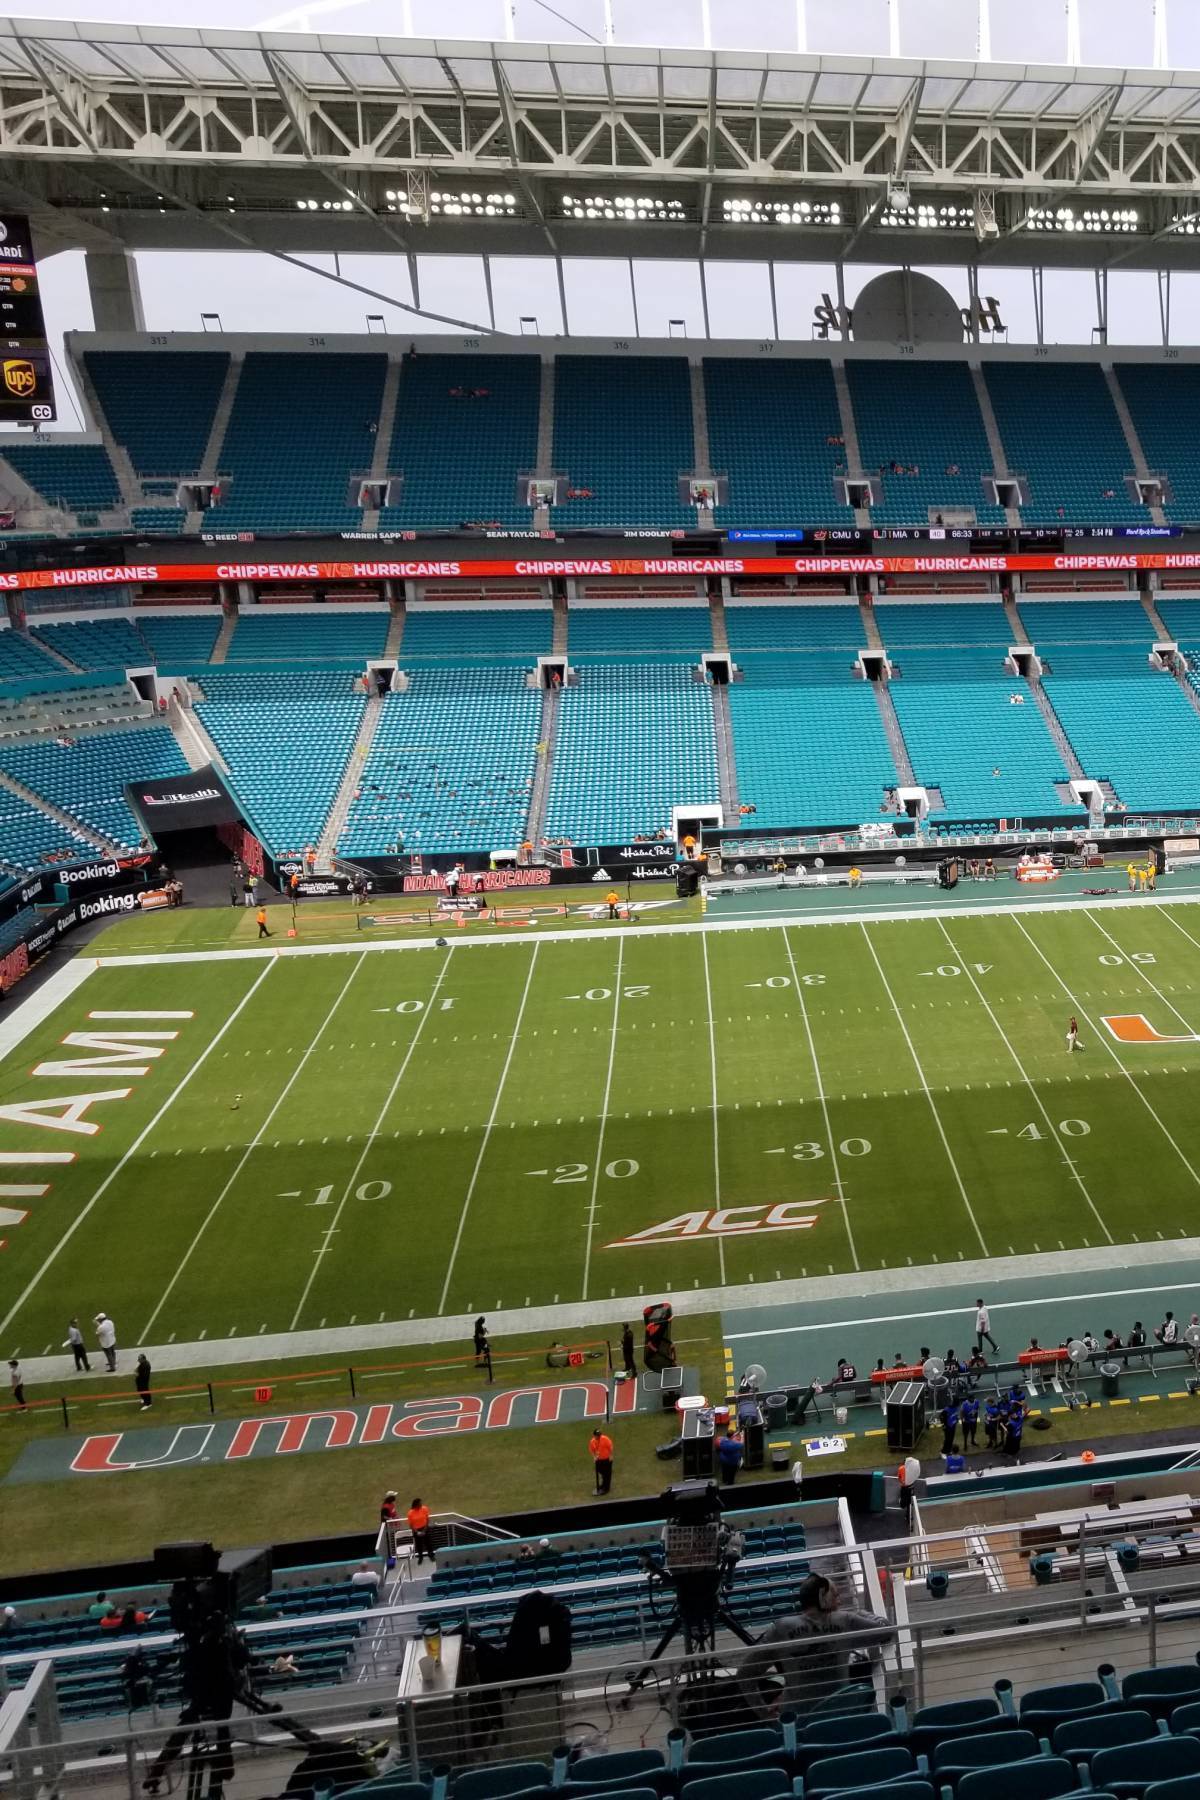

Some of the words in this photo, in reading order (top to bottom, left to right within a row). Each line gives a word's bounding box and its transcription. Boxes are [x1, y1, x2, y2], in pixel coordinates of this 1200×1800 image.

[150, 337, 167, 345] 313
[309, 337, 326, 346] 314
[463, 339, 480, 348] 315
[759, 344, 774, 352] 317
[8, 369, 34, 391] ups
[34, 406, 50, 418] CC
[34, 433, 51, 443] 312
[202, 534, 213, 542] ED
[216, 533, 237, 541] REED
[341, 532, 378, 542] WARREN
[379, 532, 401, 540] SAPP
[486, 531, 508, 539] SEAN
[509, 531, 540, 539] TAYLOR
[639, 530, 671, 538] DOOLEY
[832, 531, 851, 539] CMU
[854, 531, 860, 539] 0
[893, 530, 907, 538] MIA
[914, 530, 920, 538] 0
[952, 530, 972, 538] 66:33
[1036, 530, 1044, 538] 10
[1075, 529, 1084, 537] 25
[1105, 529, 1113, 537] PM
[515, 561, 611, 575] CHIPPEWAS
[644, 560, 743, 573] HURRICANES
[795, 559, 884, 572] CHIPPEWAS
[915, 557, 1007, 571] HURRICANES
[1054, 556, 1138, 569] CHIPPEWAS
[53, 566, 158, 584] HURRICANES
[217, 564, 318, 578] CHIPPEWAS
[354, 562, 460, 576] HURRICANES
[403, 875, 447, 892] MIAM
[1098, 951, 1158, 966] 50
[936, 963, 995, 978] 40
[766, 973, 827, 989] 30
[584, 985, 652, 1001] 20
[395, 997, 461, 1014] 10
[1016, 1118, 1092, 1142] 40
[792, 1137, 872, 1162] 30
[551, 1158, 640, 1185] 20
[304, 1180, 393, 1208] 10
[602, 1199, 831, 1249] ACC
[843, 1368, 853, 1378] 22
